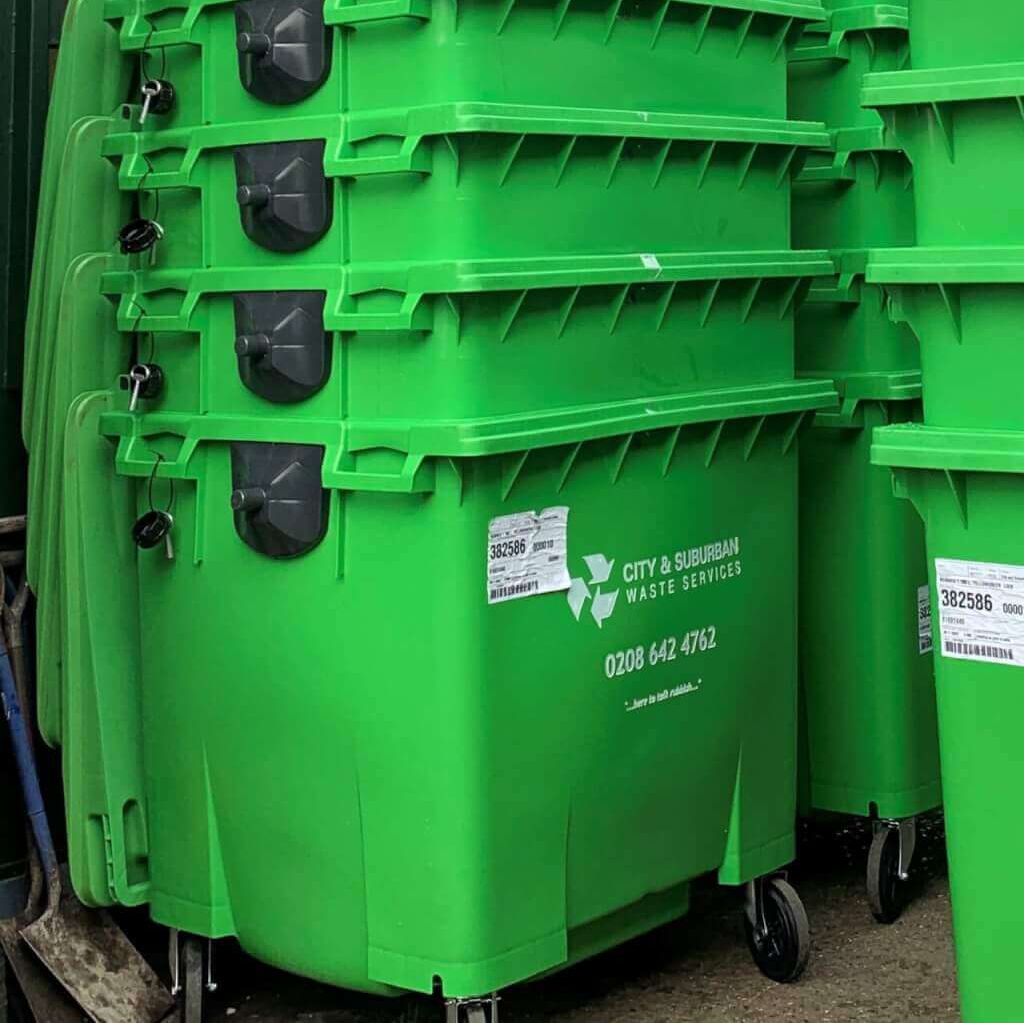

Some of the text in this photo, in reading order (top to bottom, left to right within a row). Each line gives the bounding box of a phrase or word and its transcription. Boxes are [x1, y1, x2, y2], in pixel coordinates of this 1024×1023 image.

[489, 538, 526, 560] 382586
[622, 537, 739, 583] CITY & SUBURBAN
[626, 560, 742, 604] WASTE SERVICES
[940, 589, 993, 612] 382586
[605, 625, 716, 678] 0208 642 4762
